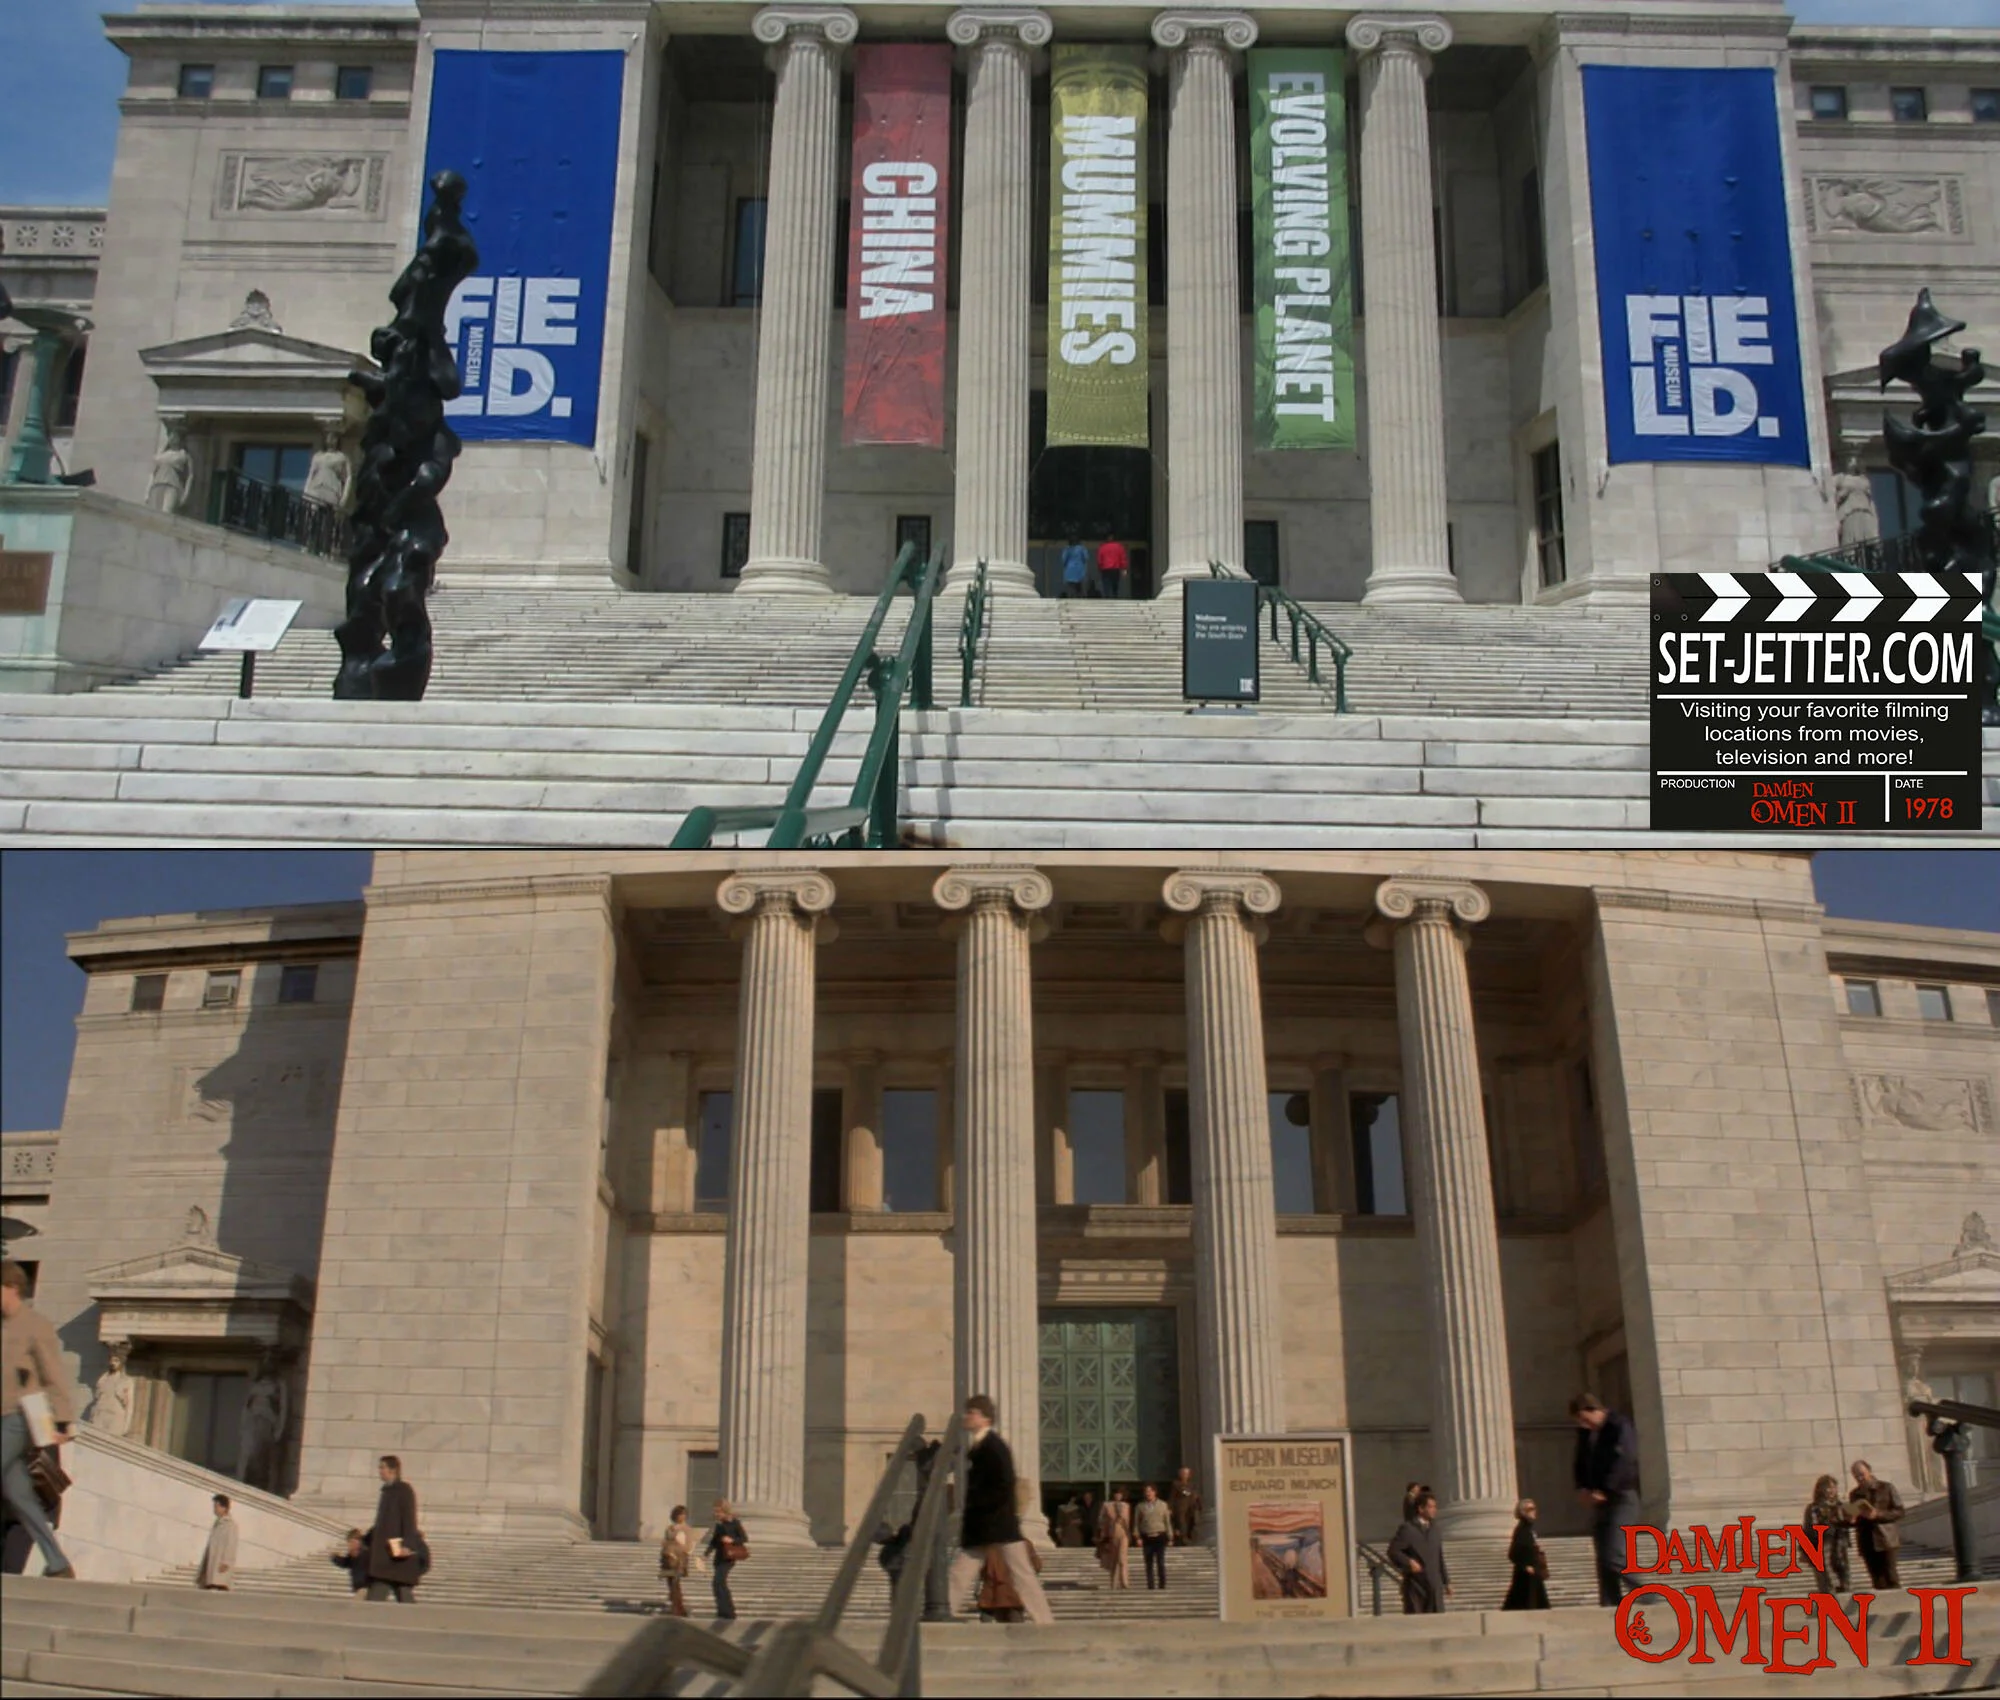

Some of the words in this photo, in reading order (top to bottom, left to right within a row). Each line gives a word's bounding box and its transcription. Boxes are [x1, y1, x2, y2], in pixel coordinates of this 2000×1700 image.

[1268, 71, 1331, 257] EVOLVING
[859, 161, 937, 319] CHINA
[1060, 115, 1136, 365] MUMMIES
[464, 325, 485, 388] MUSEUM
[1274, 266, 1335, 422] PLANET
[1662, 344, 1682, 408] MUSEUM
[1227, 1447, 1276, 1468] THORN
[1280, 1447, 1339, 1467] MUSEUM
[1291, 1478, 1337, 1490] MUNCH
